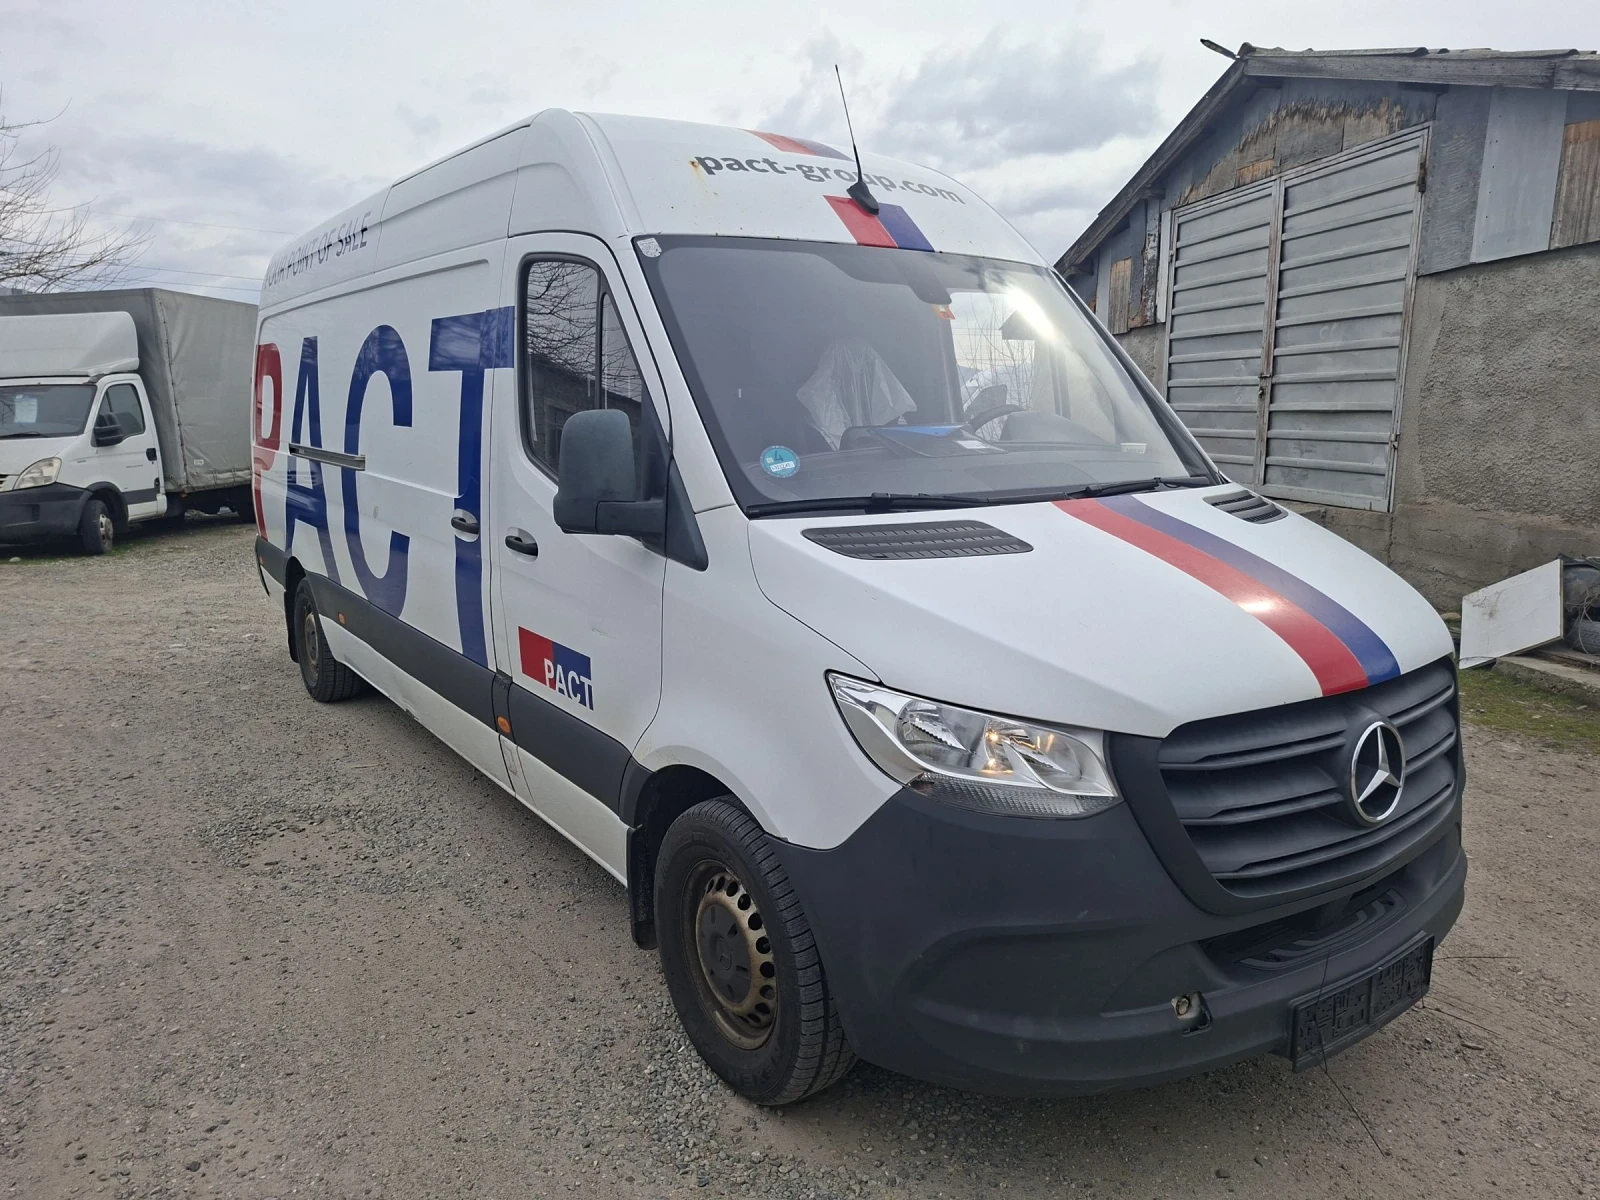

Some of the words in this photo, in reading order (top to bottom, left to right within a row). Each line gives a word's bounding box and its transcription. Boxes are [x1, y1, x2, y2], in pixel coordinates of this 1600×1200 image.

[695, 156, 967, 205] pact-group.com
[286, 237, 319, 280] POINT
[317, 228, 337, 265] OF
[335, 210, 372, 257] SALE
[252, 305, 516, 668] PACT
[543, 657, 595, 711] PACT
